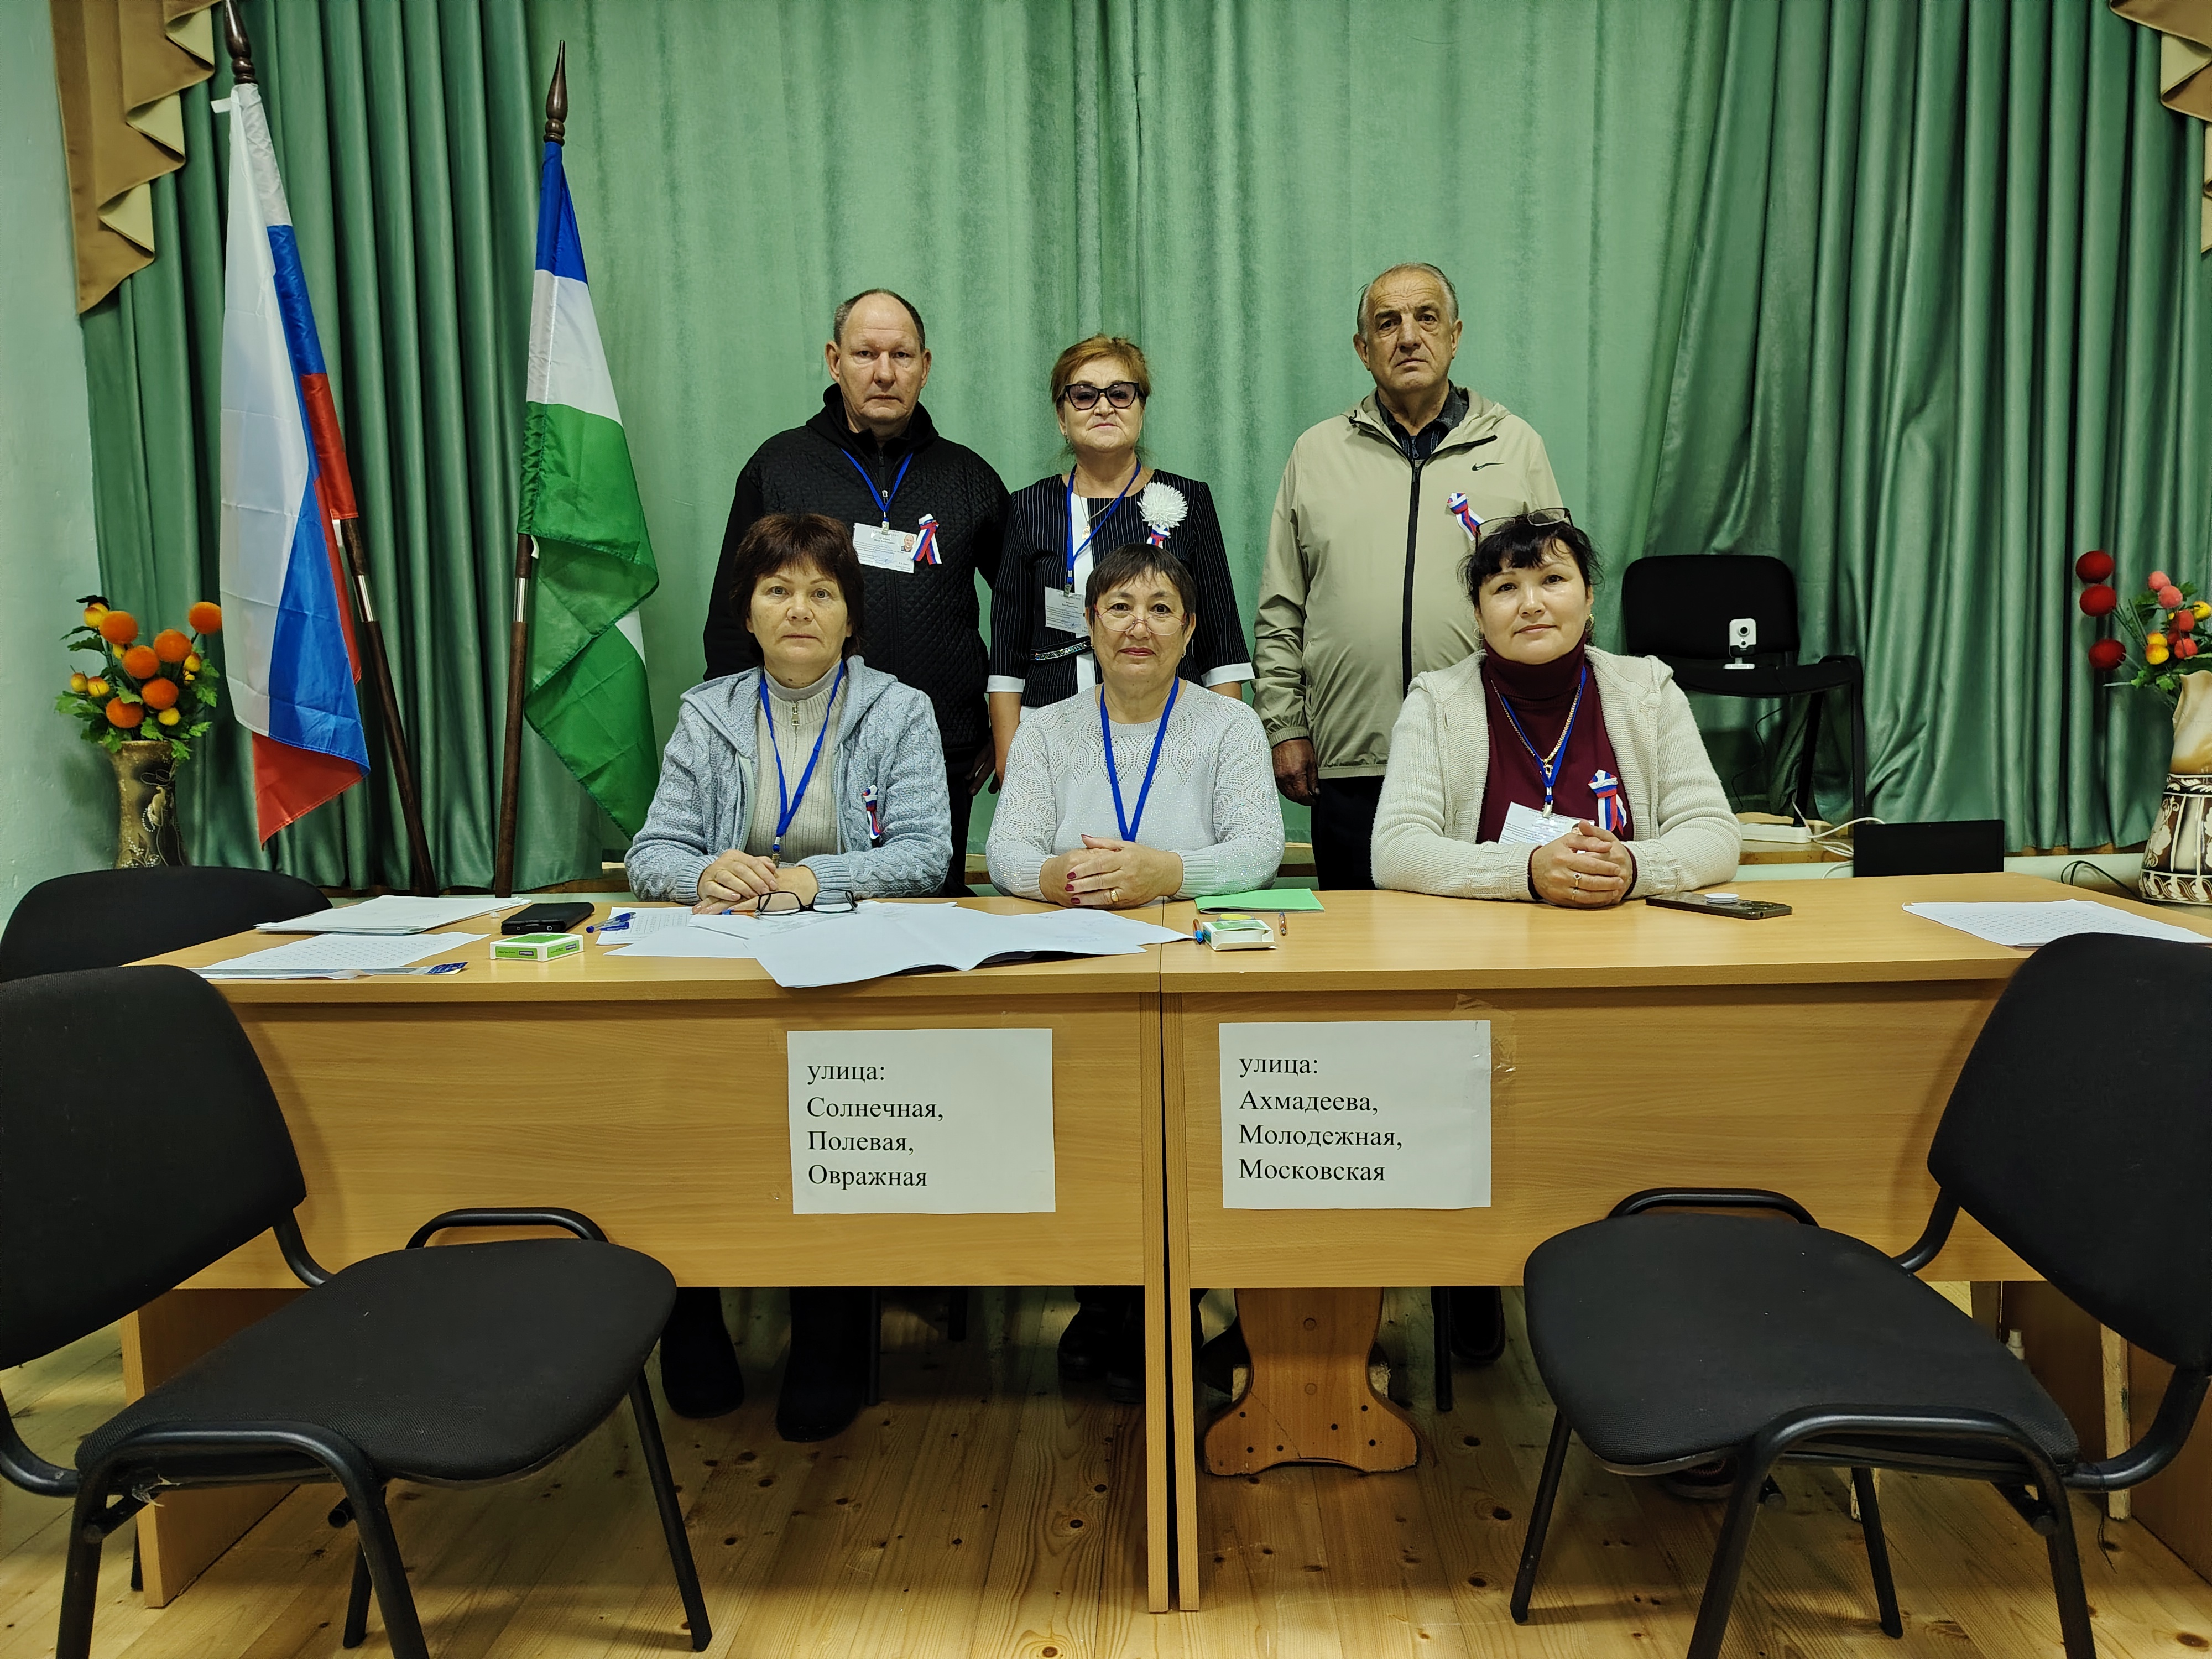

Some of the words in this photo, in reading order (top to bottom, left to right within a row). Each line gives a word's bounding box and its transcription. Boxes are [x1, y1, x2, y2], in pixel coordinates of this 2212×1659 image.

[807, 1065, 884, 1085] улица:
[1239, 1058, 1318, 1078] улица:
[807, 1096, 944, 1122] Солнечная,
[1239, 1089, 1378, 1116] Ахмадеева,
[807, 1130, 914, 1155] Полевая,
[1239, 1124, 1402, 1151] Молодежная,
[808, 1164, 928, 1191] Овражная
[1239, 1159, 1386, 1182] Московская
